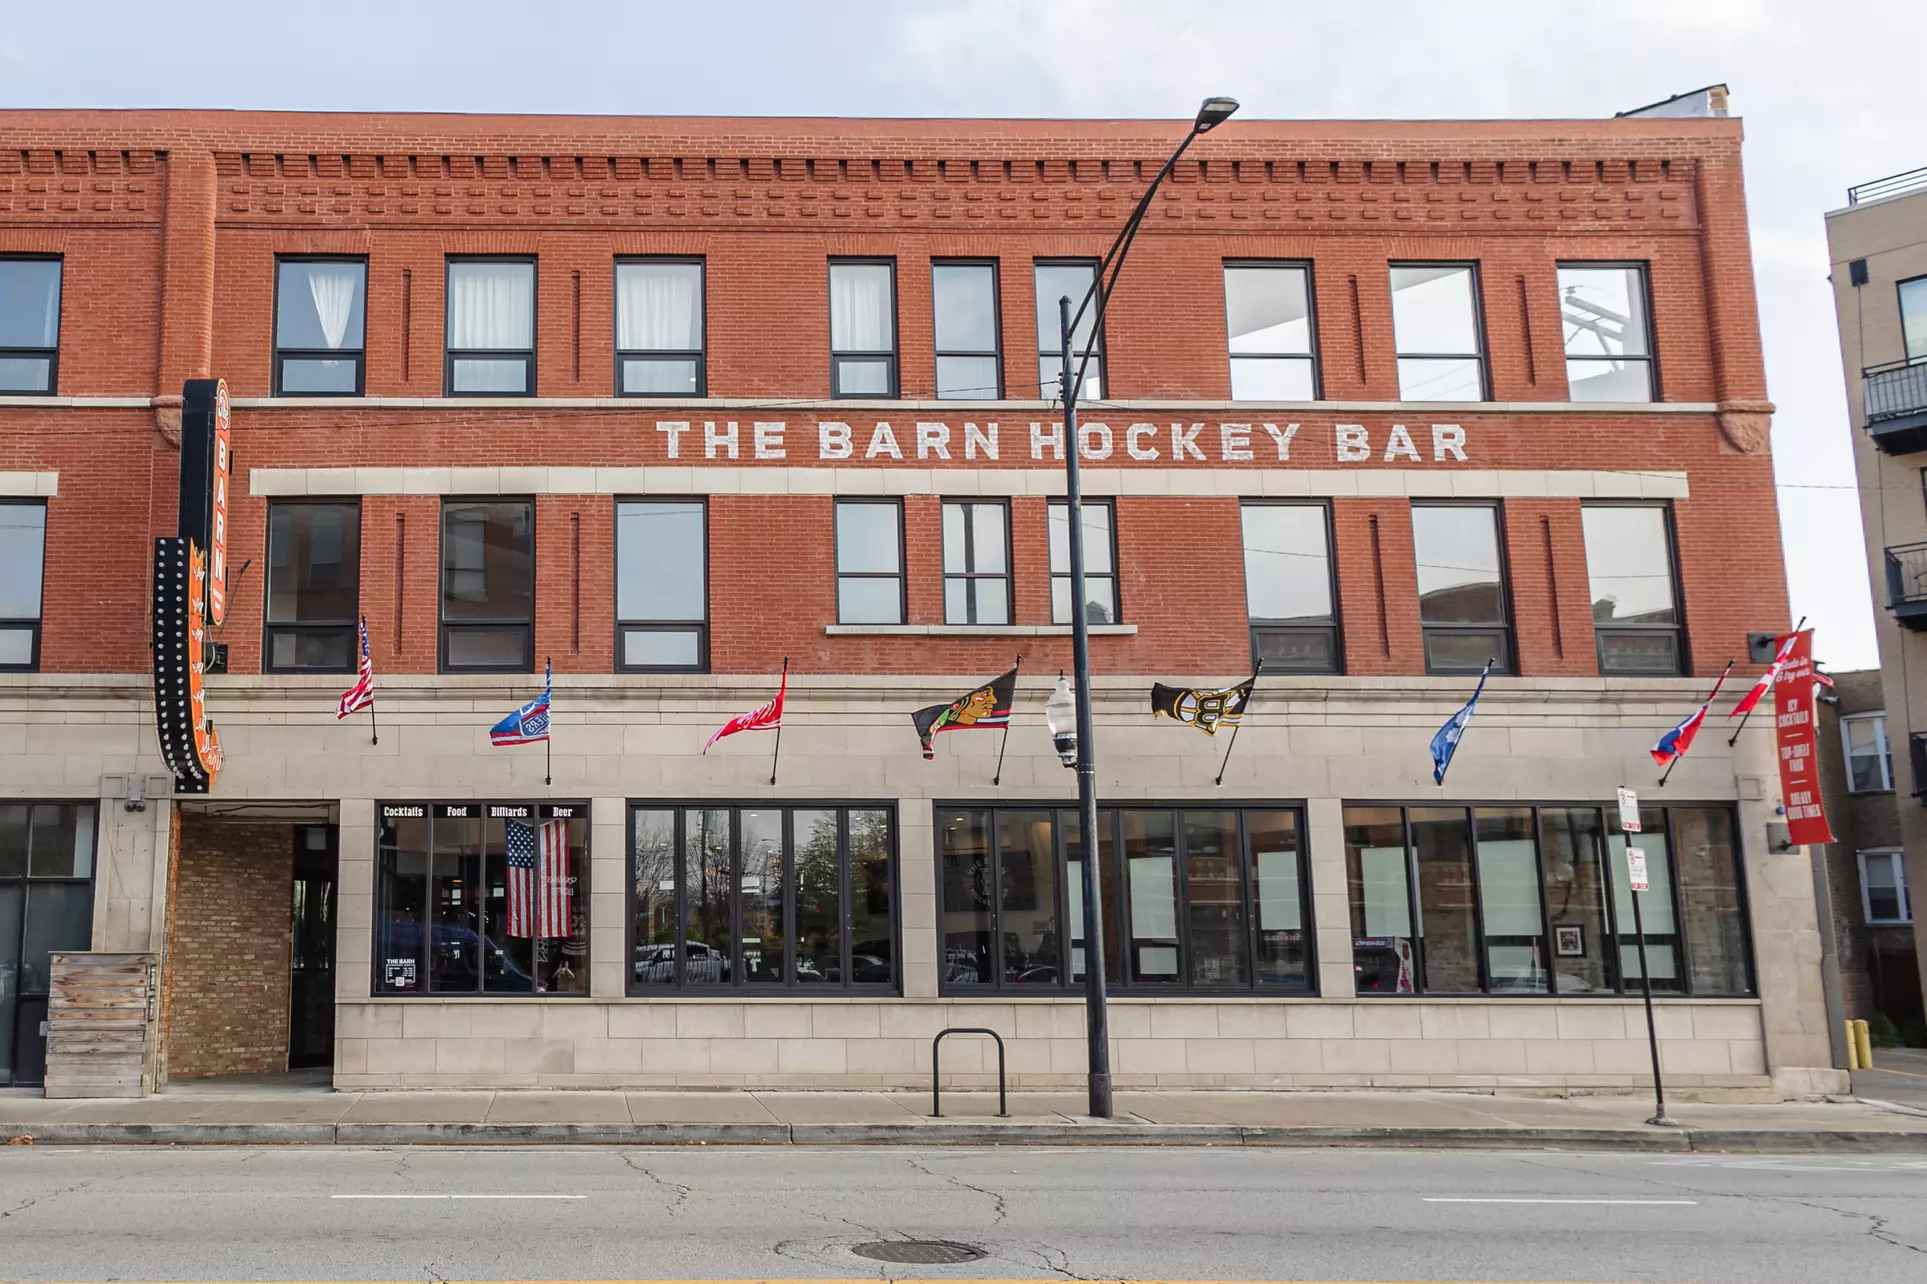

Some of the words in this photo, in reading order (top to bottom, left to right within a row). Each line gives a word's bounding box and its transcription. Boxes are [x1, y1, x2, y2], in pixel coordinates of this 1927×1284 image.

[656, 421, 787, 460] THE
[818, 421, 1000, 461] BARN
[1029, 422, 1300, 462] HOCKEY
[1335, 423, 1469, 463] BAR
[215, 435, 226, 584] BARN
[1787, 698, 1799, 712] ICY
[1778, 710, 1809, 728] COCKTAILS
[1781, 743, 1811, 760] TOP-SHELF
[1789, 758, 1804, 772] FOOD
[383, 806, 423, 817] Cocktails
[447, 806, 467, 817] Food
[491, 806, 528, 817] Billiards
[552, 806, 573, 817] Beer
[1787, 806, 1804, 820] GOOD
[1802, 804, 1822, 818] TIMES
